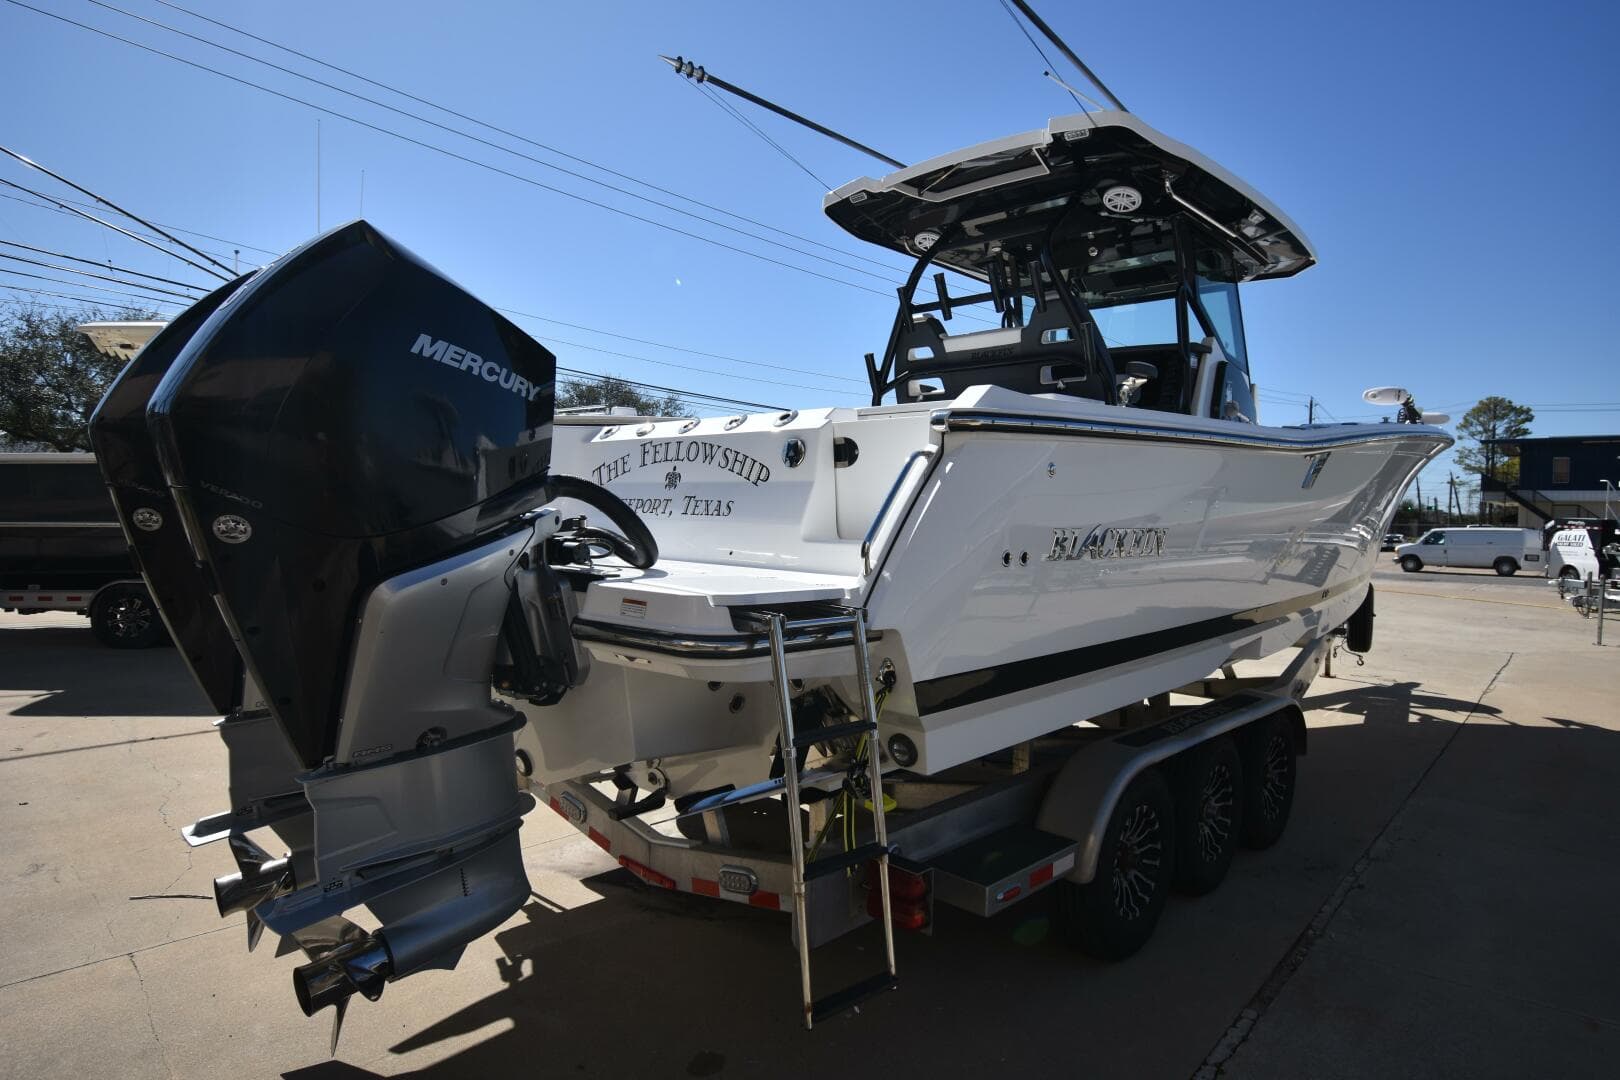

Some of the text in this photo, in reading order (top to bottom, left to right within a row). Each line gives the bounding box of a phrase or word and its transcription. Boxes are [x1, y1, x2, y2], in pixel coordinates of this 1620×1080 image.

[410, 333, 540, 401] MERCURY
[592, 440, 770, 487] THE FELLOWSHIP
[621, 495, 735, 519] EPORT, TEXAS
[1047, 524, 1169, 561] BLACKFIN
